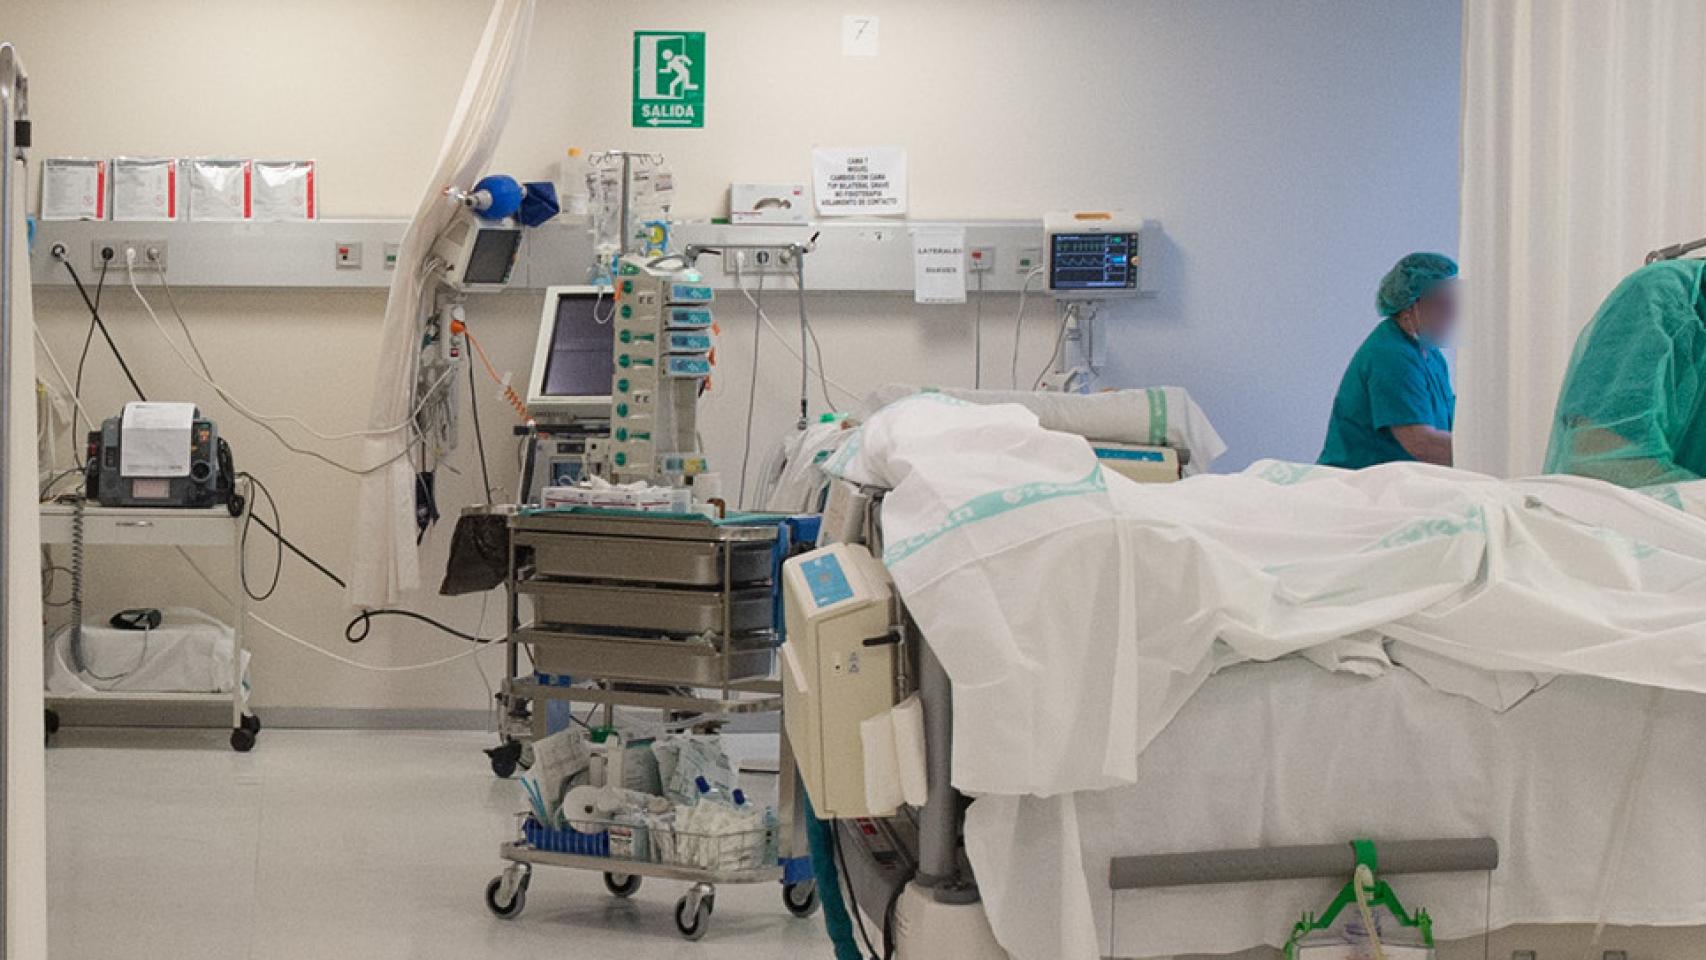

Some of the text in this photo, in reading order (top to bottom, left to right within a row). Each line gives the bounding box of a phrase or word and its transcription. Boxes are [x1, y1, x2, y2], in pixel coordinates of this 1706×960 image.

[854, 18, 870, 41] 7
[641, 103, 695, 118] SALIDA
[839, 181, 868, 189] BILATERAL
[867, 198, 897, 206] CONTACTO
[918, 247, 962, 255] LATERALES
